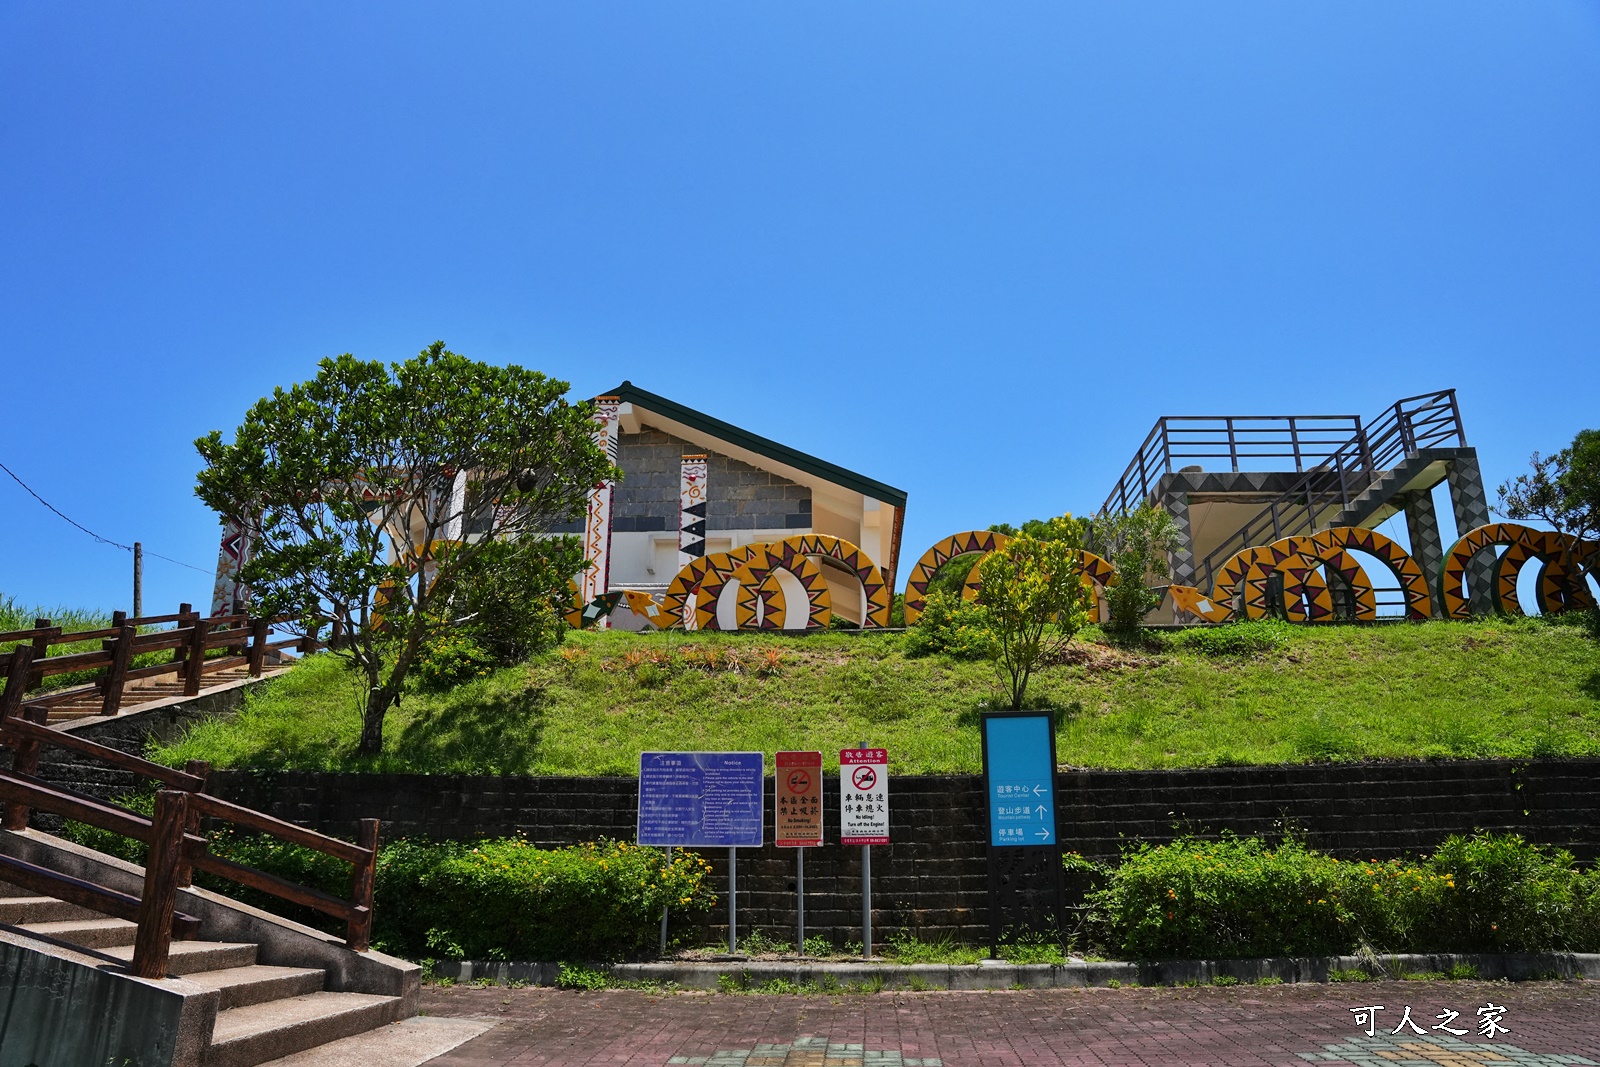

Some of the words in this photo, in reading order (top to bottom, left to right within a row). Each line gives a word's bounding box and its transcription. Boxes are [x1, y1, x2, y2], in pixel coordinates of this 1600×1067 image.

[997, 785, 1030, 793] 遊客中心
[845, 793, 884, 802] 車輛怠速
[780, 806, 818, 815] 禁止吸菸
[845, 804, 884, 813] 停車熄火
[999, 828, 1023, 836] 停車場
